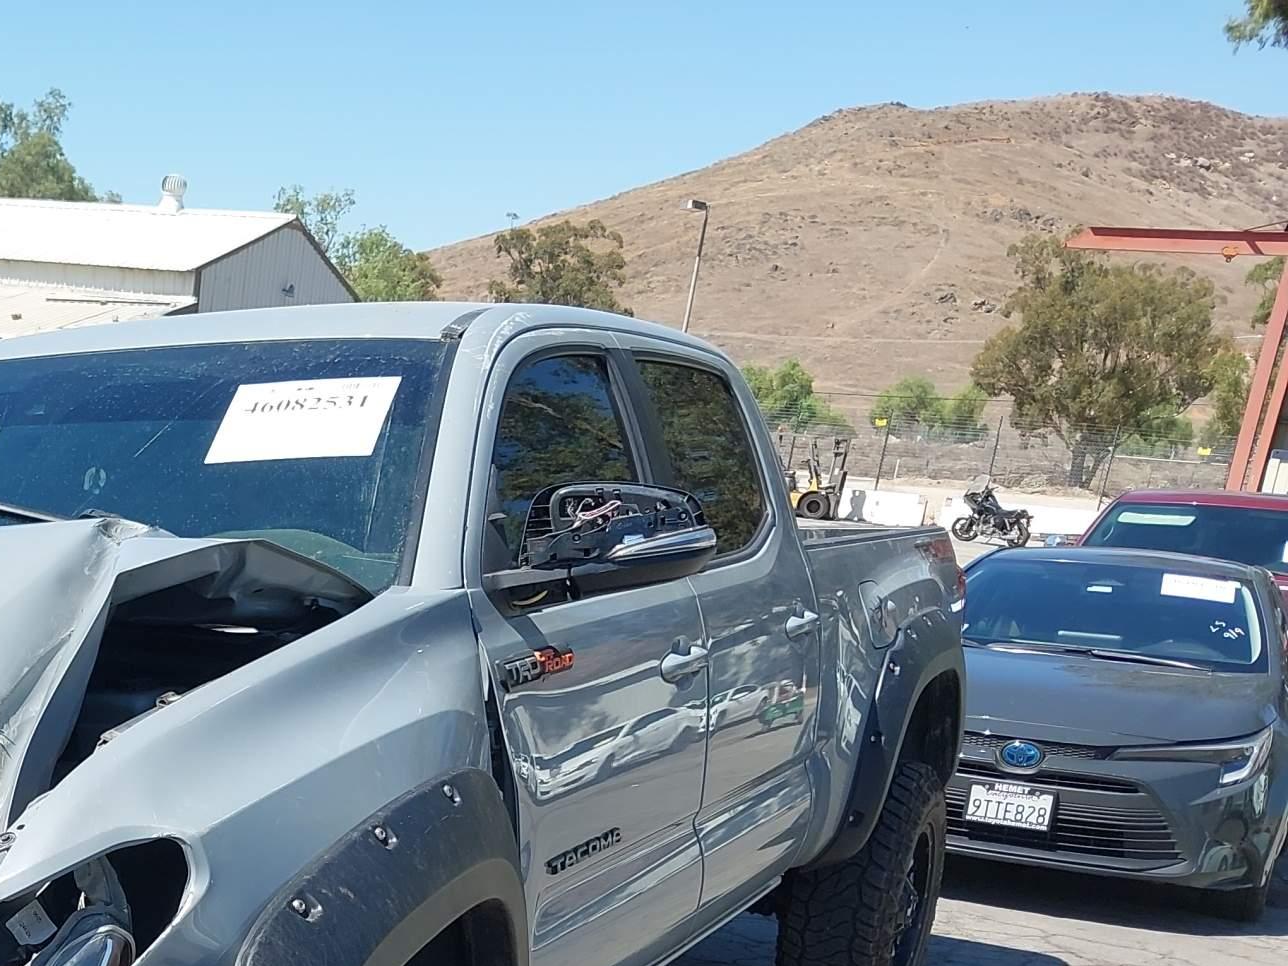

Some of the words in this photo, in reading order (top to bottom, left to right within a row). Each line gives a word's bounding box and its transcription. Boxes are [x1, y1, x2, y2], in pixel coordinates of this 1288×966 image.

[244, 394, 369, 414] 46082531
[545, 653, 575, 673] ROAD
[994, 783, 1031, 794] HEMET
[545, 827, 621, 875] TACOMA
